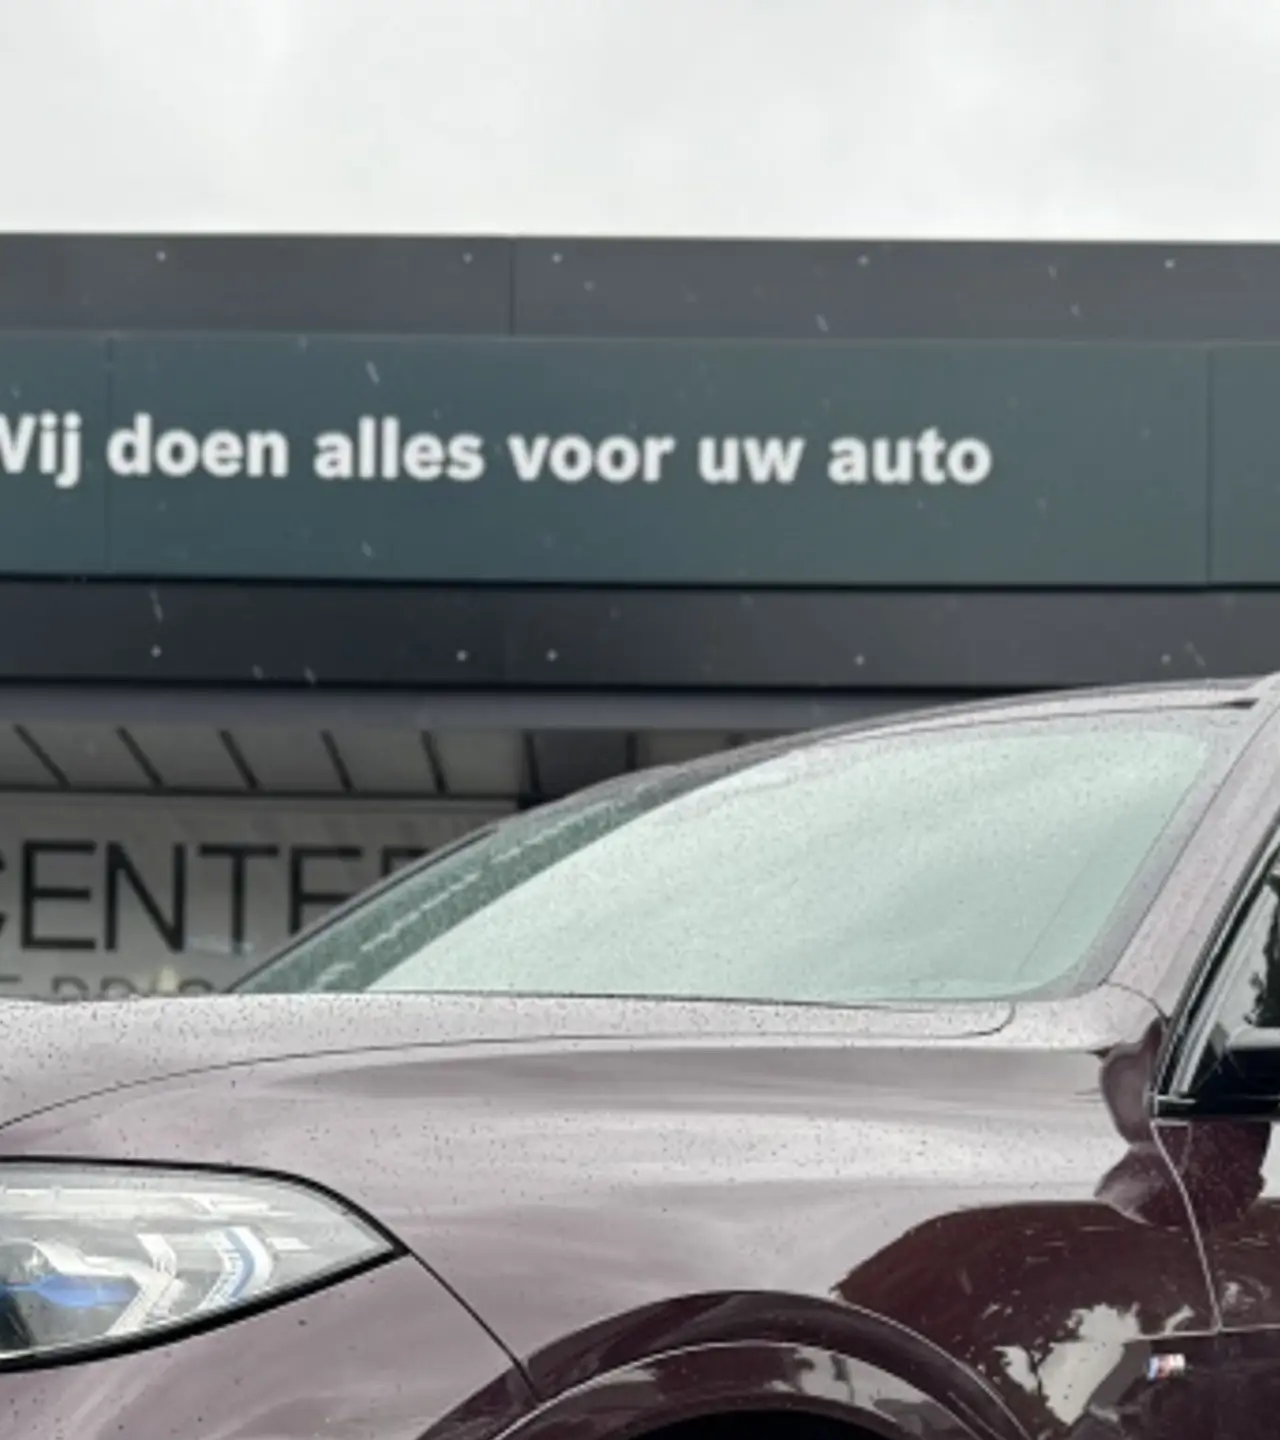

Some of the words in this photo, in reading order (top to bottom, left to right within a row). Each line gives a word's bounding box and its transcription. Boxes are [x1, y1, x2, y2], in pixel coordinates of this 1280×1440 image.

[108, 414, 287, 476] doen
[315, 417, 483, 480] alles
[509, 436, 674, 481] voor
[700, 438, 804, 482] uw
[829, 428, 991, 483] auto
